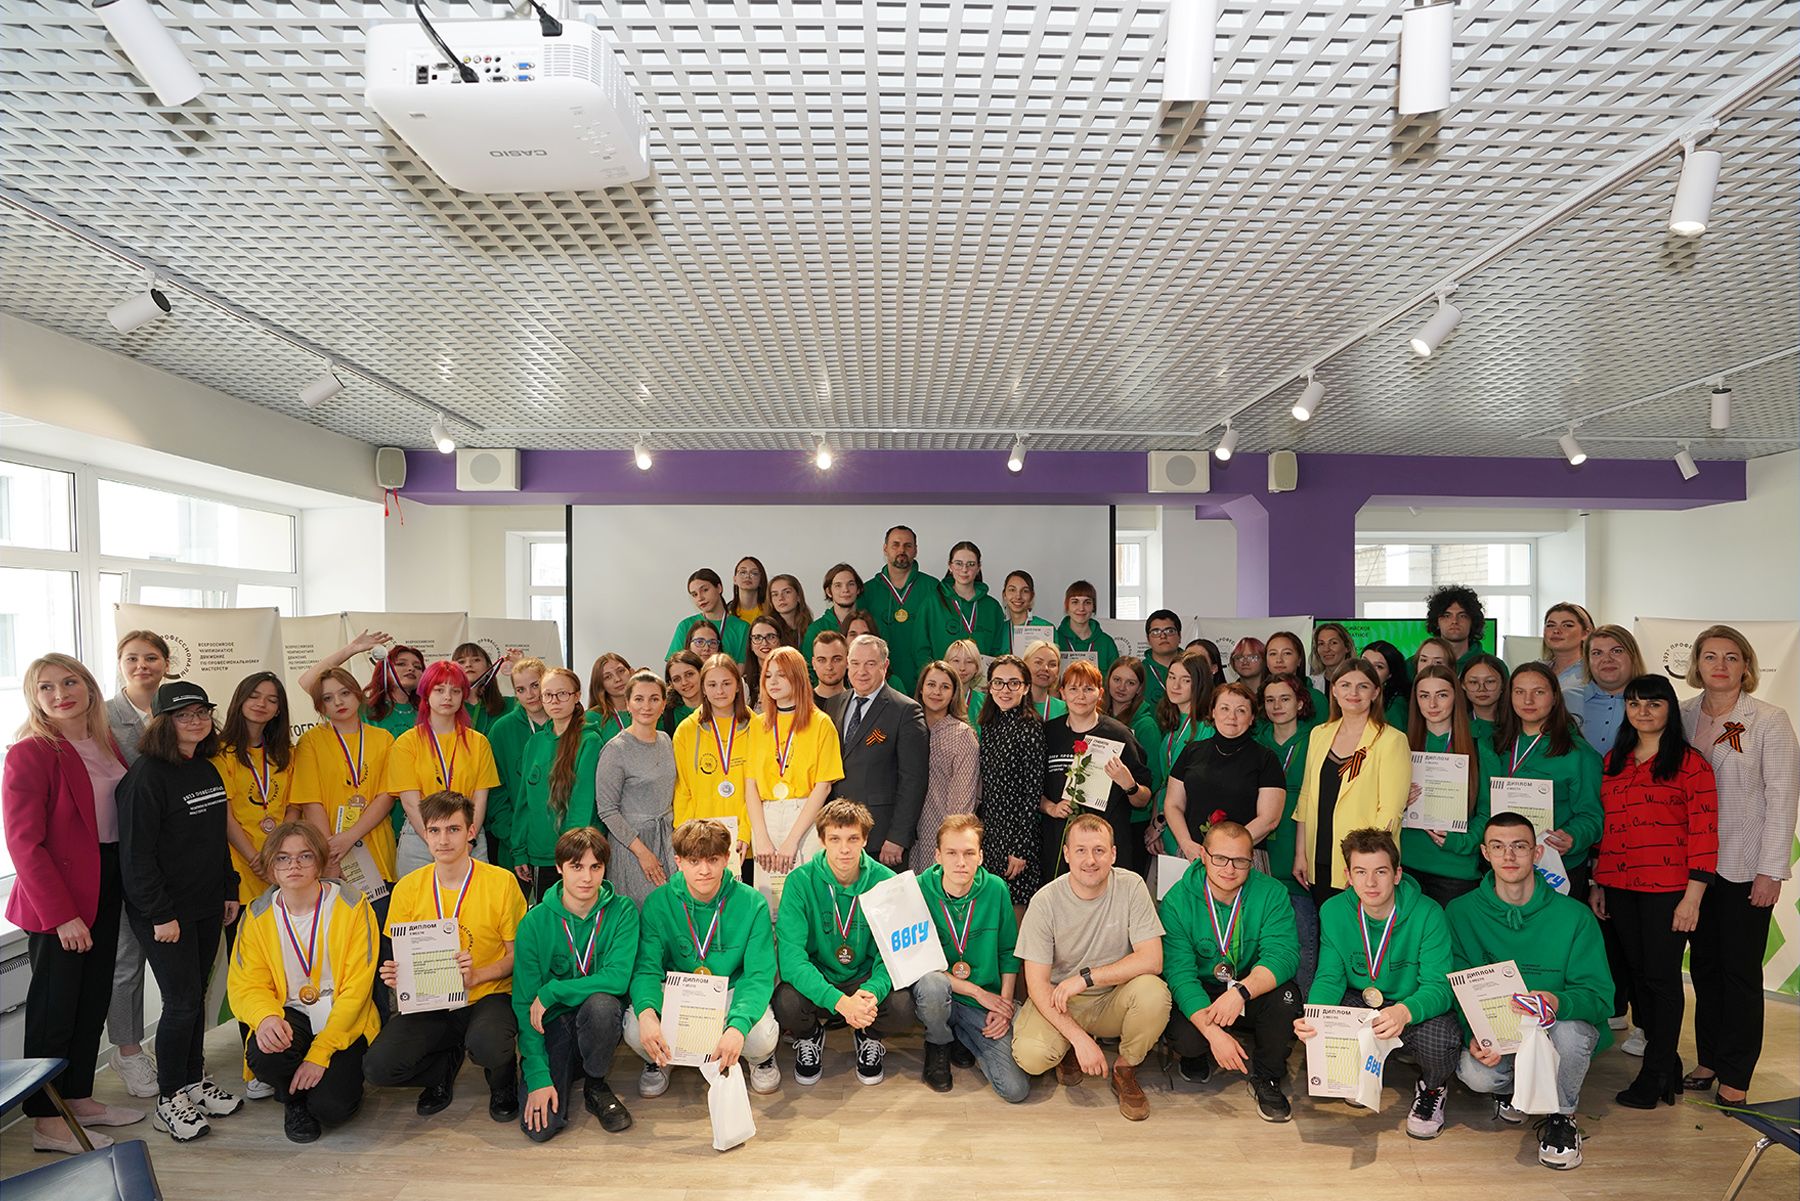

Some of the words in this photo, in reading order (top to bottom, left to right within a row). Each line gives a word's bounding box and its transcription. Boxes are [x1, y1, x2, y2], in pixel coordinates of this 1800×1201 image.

[489, 149, 547, 157] CASIO
[408, 923, 437, 932] ДИПЛОМ
[891, 920, 929, 952] ВВГУ
[1467, 968, 1495, 979] ДИПЛОМ
